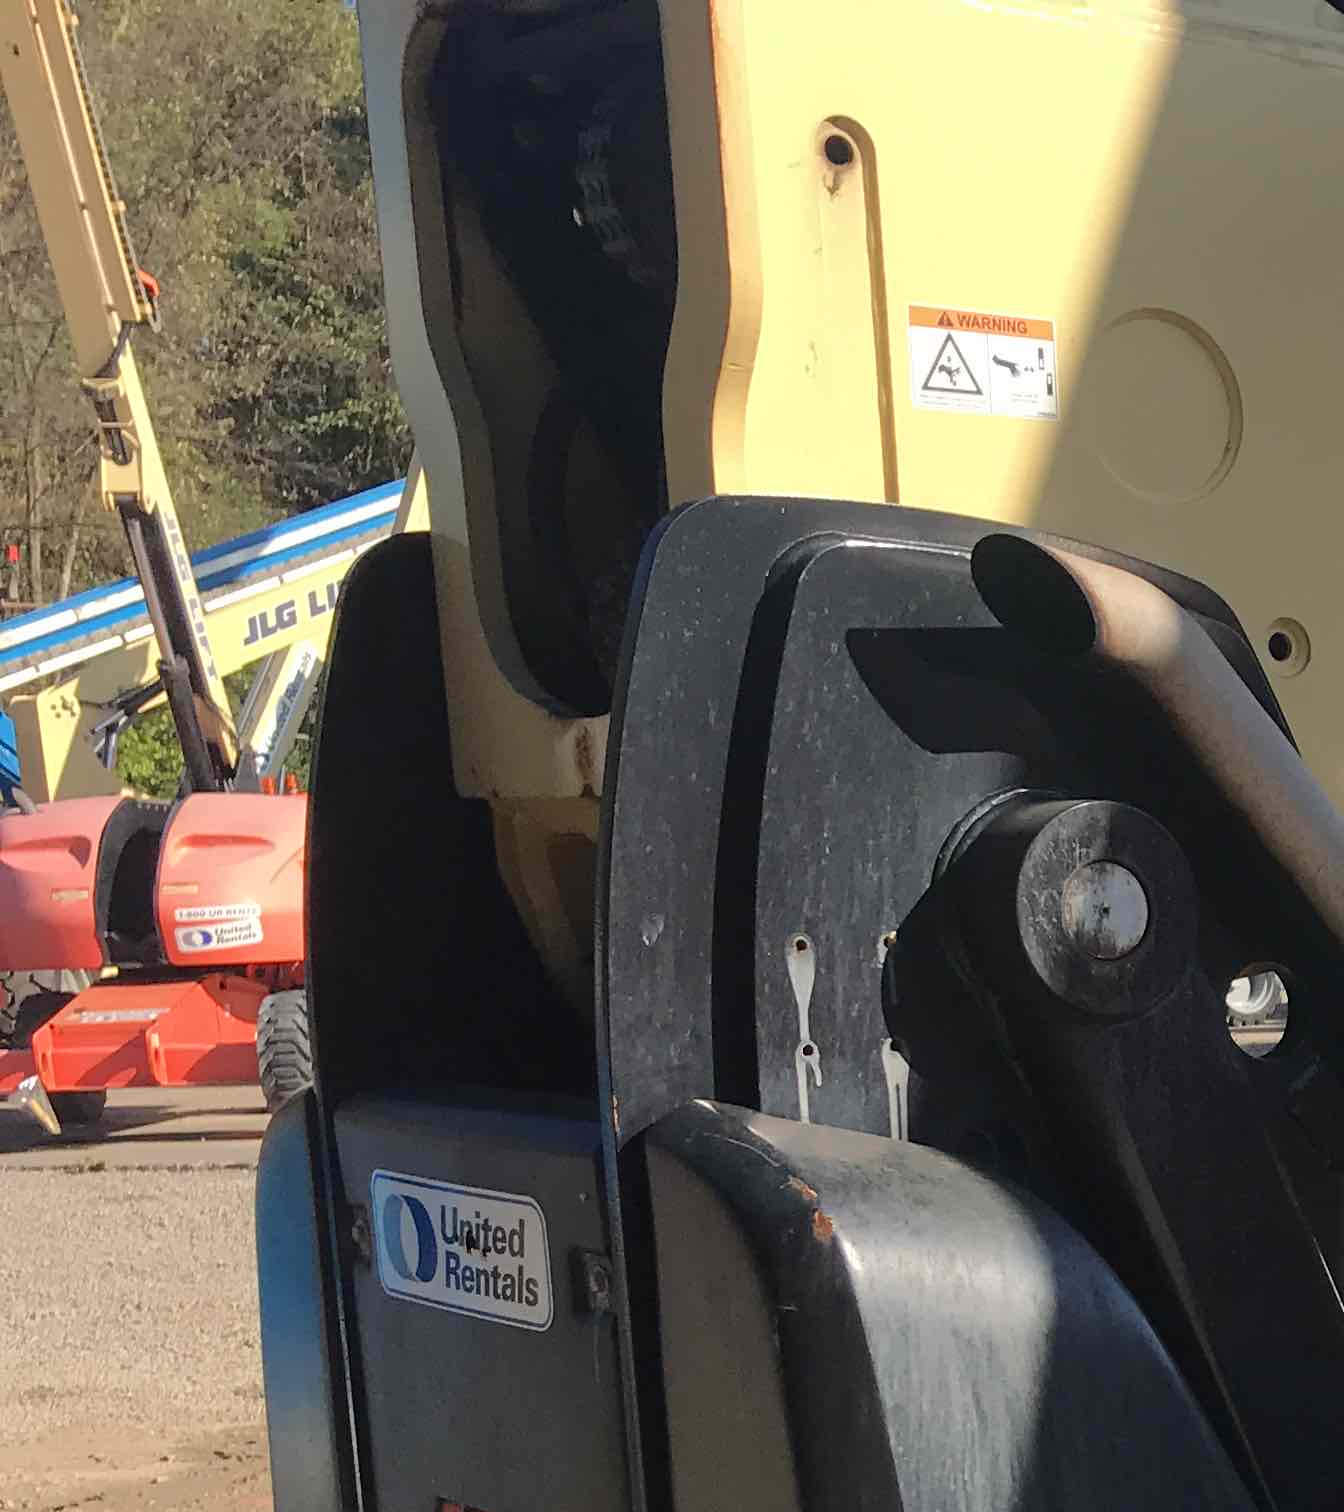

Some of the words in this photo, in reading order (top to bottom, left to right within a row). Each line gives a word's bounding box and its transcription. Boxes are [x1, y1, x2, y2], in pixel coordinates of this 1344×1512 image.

[956, 313, 1028, 334] WARNING
[243, 599, 298, 647] JLG
[307, 580, 342, 617] LI
[440, 1204, 526, 1259] United
[444, 1250, 539, 1307] Rentals
